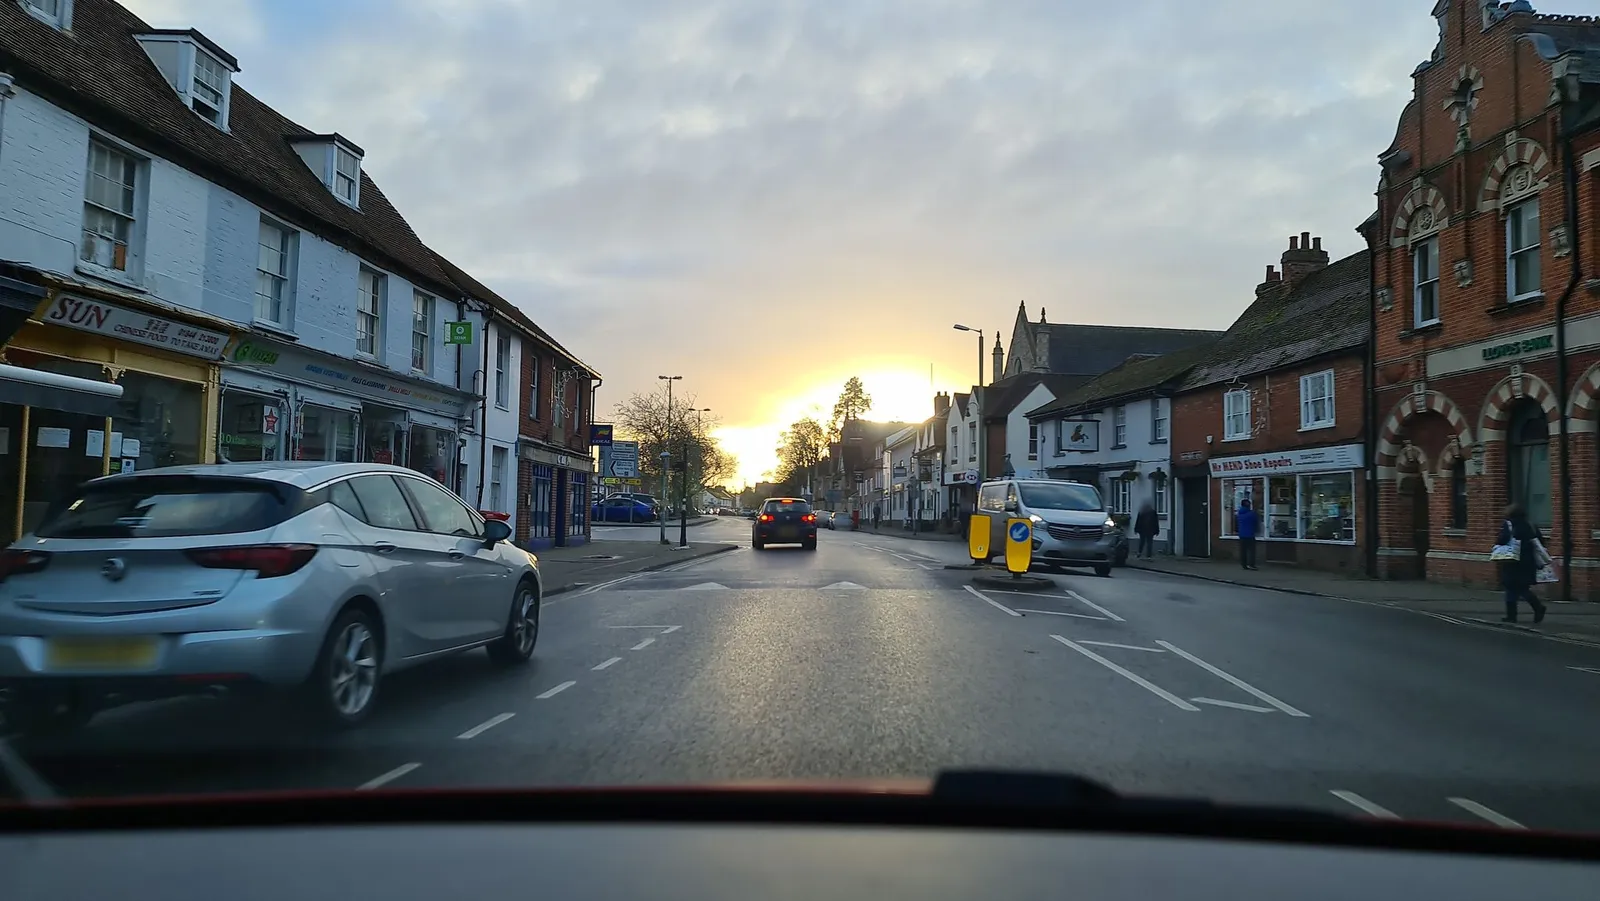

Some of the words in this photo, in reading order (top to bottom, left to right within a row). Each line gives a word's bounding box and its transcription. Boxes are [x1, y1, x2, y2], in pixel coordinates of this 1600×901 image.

[50, 298, 112, 329] SUN
[113, 324, 147, 338] CHINESE
[147, 332, 168, 343] FOOD
[171, 337, 182, 346] TO
[199, 344, 220, 355] AWAY
[1483, 342, 1521, 361] LLOYDS
[1522, 335, 1554, 352] BANK
[1212, 462, 1222, 472] Mr
[1222, 460, 1243, 472] MEND
[1244, 459, 1263, 470] Shoe
[1263, 456, 1293, 471] Repairs
